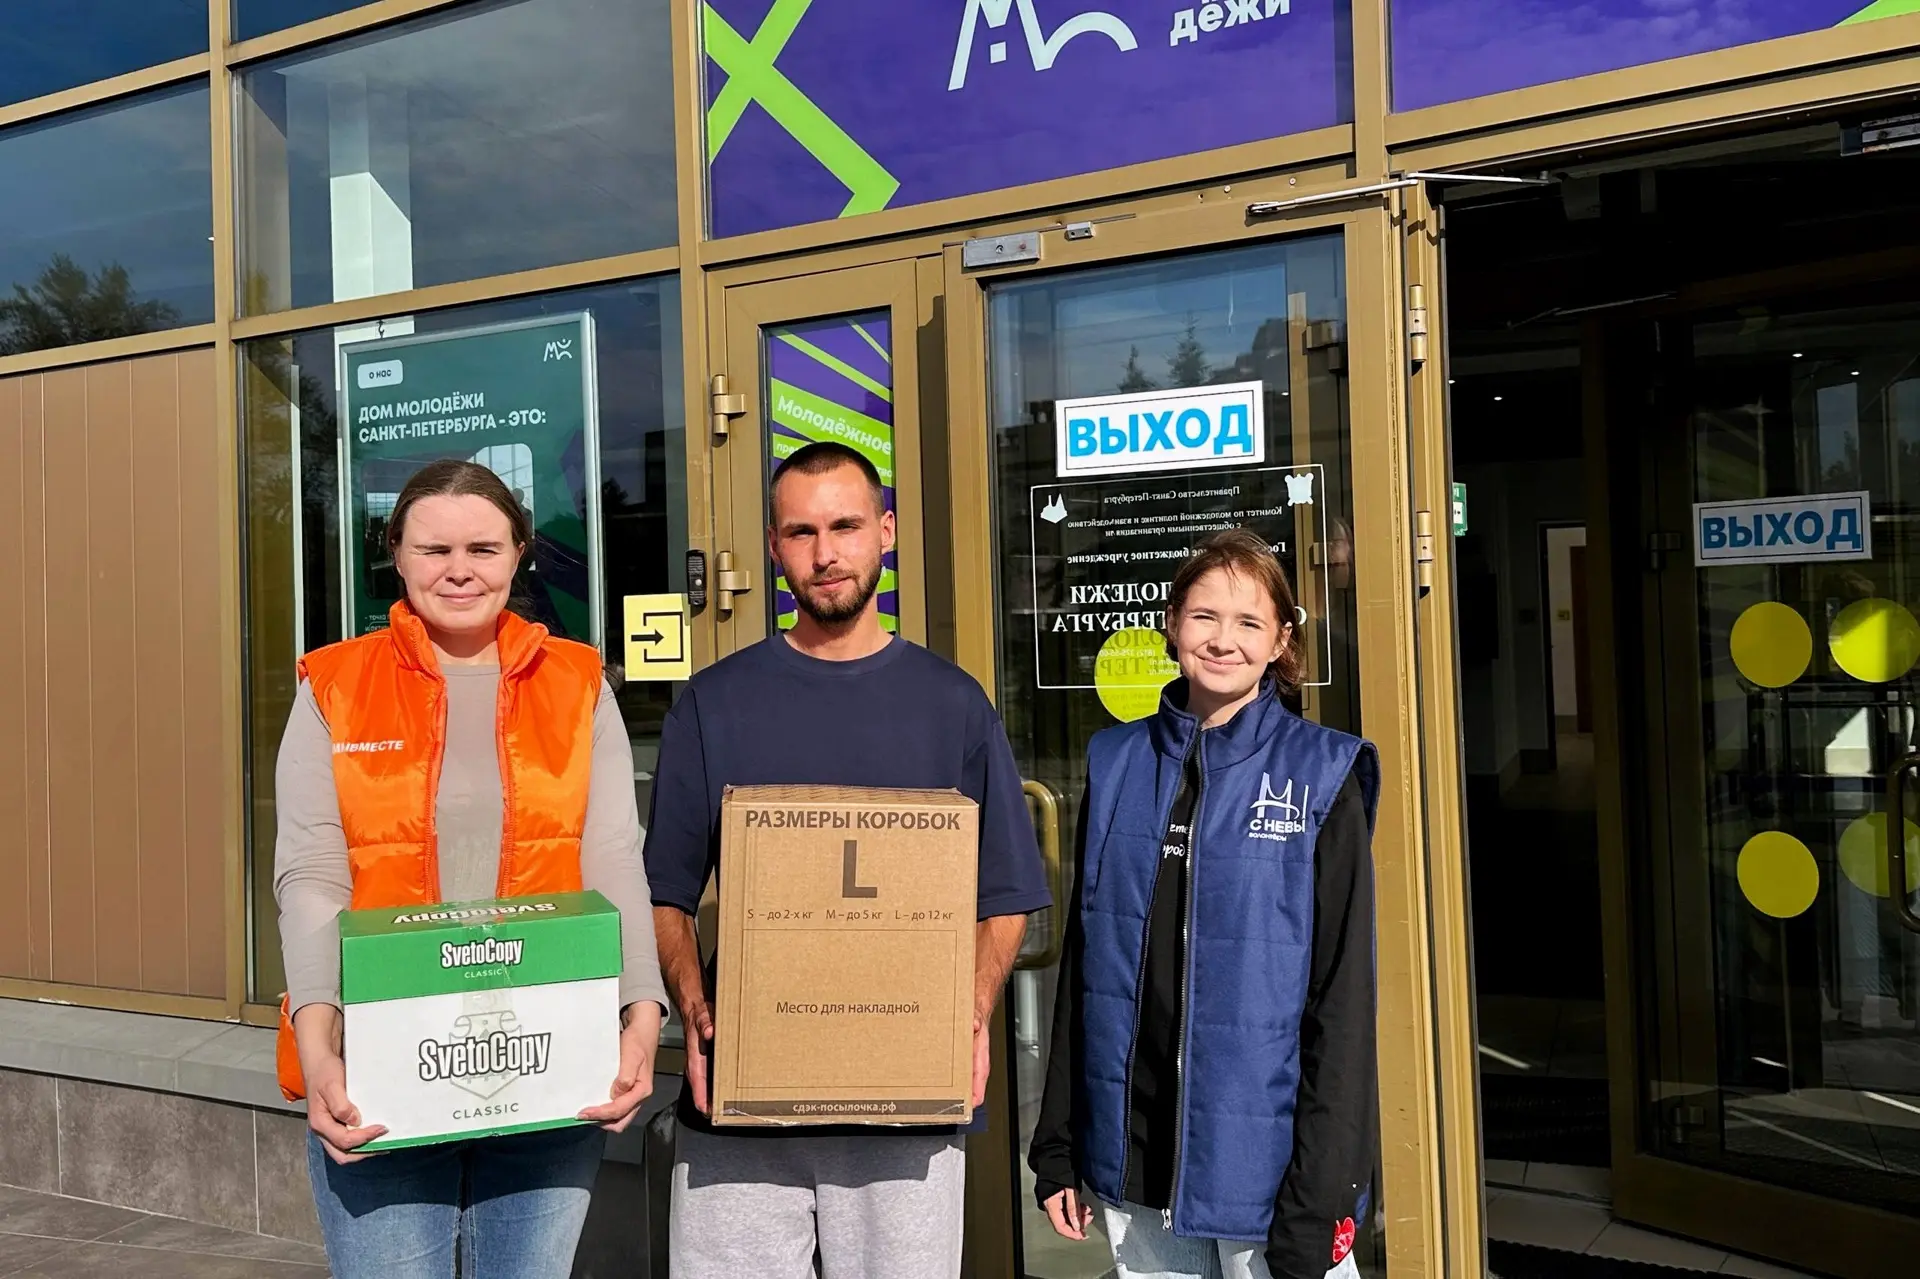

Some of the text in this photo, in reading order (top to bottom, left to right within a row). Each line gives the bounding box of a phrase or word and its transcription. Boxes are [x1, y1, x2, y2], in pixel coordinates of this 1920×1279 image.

[376, 369, 392, 379] нас
[358, 391, 484, 424] ДОМ МОЛОДЁЖИ
[359, 413, 497, 443] САНКТ-ПЕТЕРБУРГА
[508, 408, 546, 427] ЭТО:
[778, 395, 891, 455] Молодёжное
[1068, 404, 1252, 457] ВЫХОД
[1703, 508, 1860, 550] ВЫХОД
[746, 810, 961, 830] РАЗМЕРЫ КОРОБОК
[1250, 819, 1306, 834] С НЕВЫ
[842, 840, 877, 898] L
[393, 903, 558, 924] SvetoCopy
[747, 909, 754, 919] S
[767, 910, 782, 921] до
[802, 911, 814, 920] кг
[826, 909, 836, 920] M
[847, 911, 861, 922] до
[862, 909, 869, 920] 5
[871, 911, 883, 920] кг
[895, 910, 901, 920] L
[912, 912, 926, 923] до
[928, 910, 941, 920] 12
[942, 912, 954, 921] кг
[440, 936, 525, 969] SvetoCopy
[464, 968, 503, 979] CLASSIC
[776, 1001, 920, 1015] Место для накладной
[418, 1030, 552, 1082] SvetoCopy
[452, 1102, 520, 1121] CLASSIC
[792, 1101, 897, 1114] сдэк-посылочка.рф
